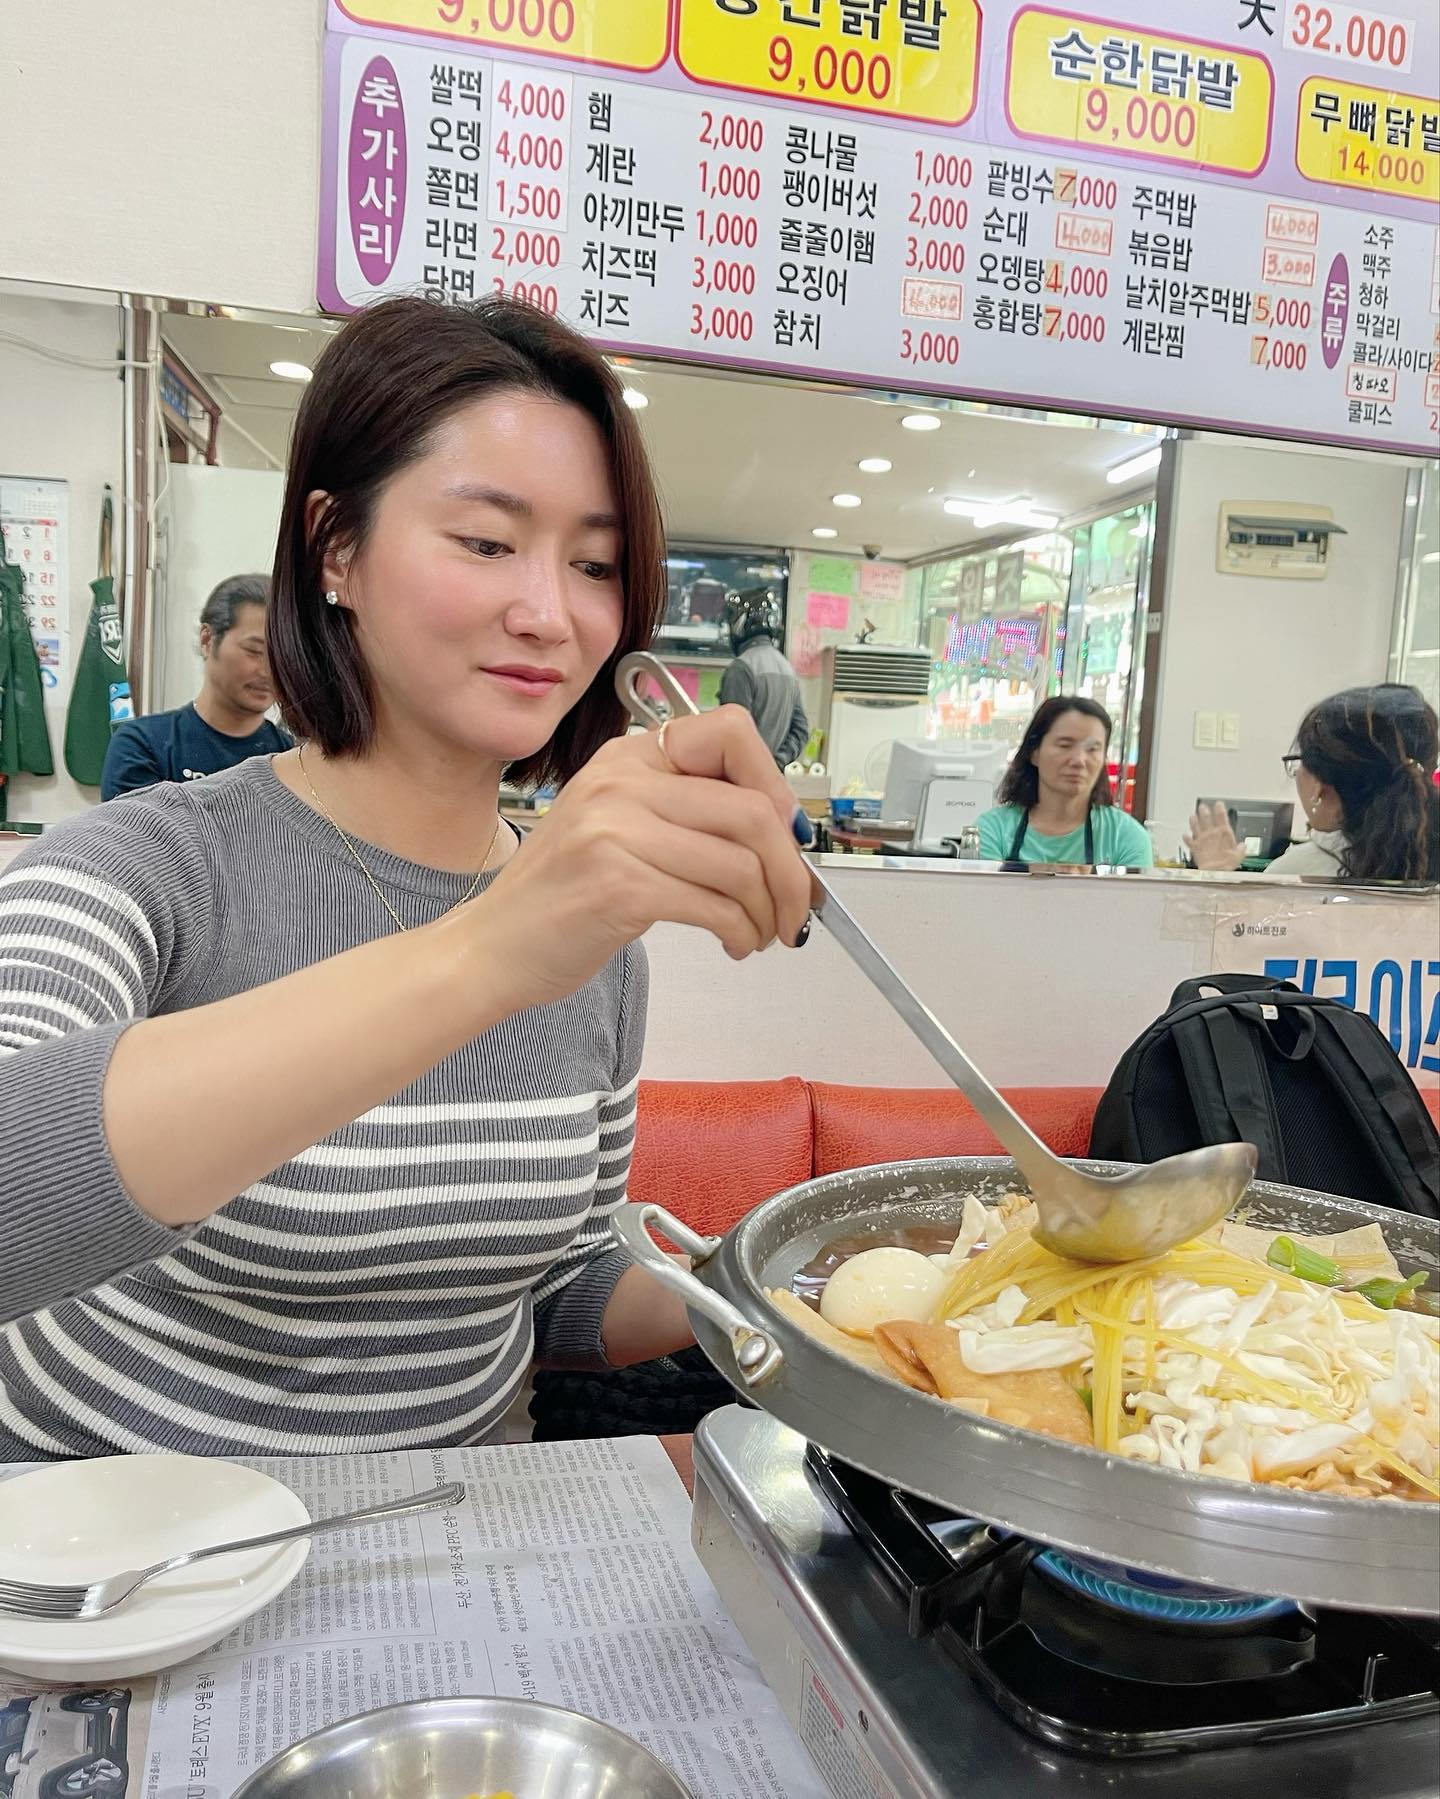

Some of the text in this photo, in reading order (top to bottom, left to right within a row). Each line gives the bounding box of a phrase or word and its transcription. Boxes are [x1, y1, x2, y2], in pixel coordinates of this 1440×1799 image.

[716, 0, 947, 50] 닭발
[1292, 4, 1406, 66] 32.000
[430, 64, 565, 121] 쌀떡 4,000
[769, 35, 891, 100] 9,000
[1051, 31, 1238, 111] 순한닭발
[427, 116, 563, 171] 오뎅 4,000
[588, 91, 763, 152] 햄 2,000
[1087, 88, 1195, 148] 9,000
[359, 77, 399, 264] 추가사리
[586, 142, 760, 200] 계란 1,000
[785, 124, 972, 188] 콩나물 1,000
[425, 165, 561, 220] 쫄면 1,500
[782, 168, 968, 231] 팽이버섯 2,000
[988, 160, 1117, 209] 팥빙수 7,000
[1132, 185, 1197, 228] 주먹밥
[425, 218, 560, 268] 라면 2,000
[583, 192, 758, 249] 야끼만두 1,000
[779, 217, 965, 274] 줄줄이햄 3,000
[983, 206, 1028, 247] 순대
[1364, 223, 1394, 251] 소주
[581, 240, 755, 295] 치즈떡 3,000
[976, 252, 1108, 298] 오뎅탕 4,000
[1128, 229, 1193, 273] 볶음밥
[1363, 253, 1392, 280] 맥주
[775, 261, 848, 305] 오징어
[1126, 275, 1311, 329] 날치알주먹밥 5,000
[1359, 282, 1389, 310] 청하
[579, 288, 753, 341] 치즈 3,000
[773, 308, 959, 365] 참치 3,000
[973, 294, 1105, 343] 홍합탕 7,000
[1323, 283, 1346, 349] 주류
[1356, 312, 1400, 341] 막걸리
[1122, 318, 1307, 370] 계란찜 7,000
[1353, 341, 1434, 374] 콜라/사이다
[1348, 399, 1393, 426] 쿨피스
